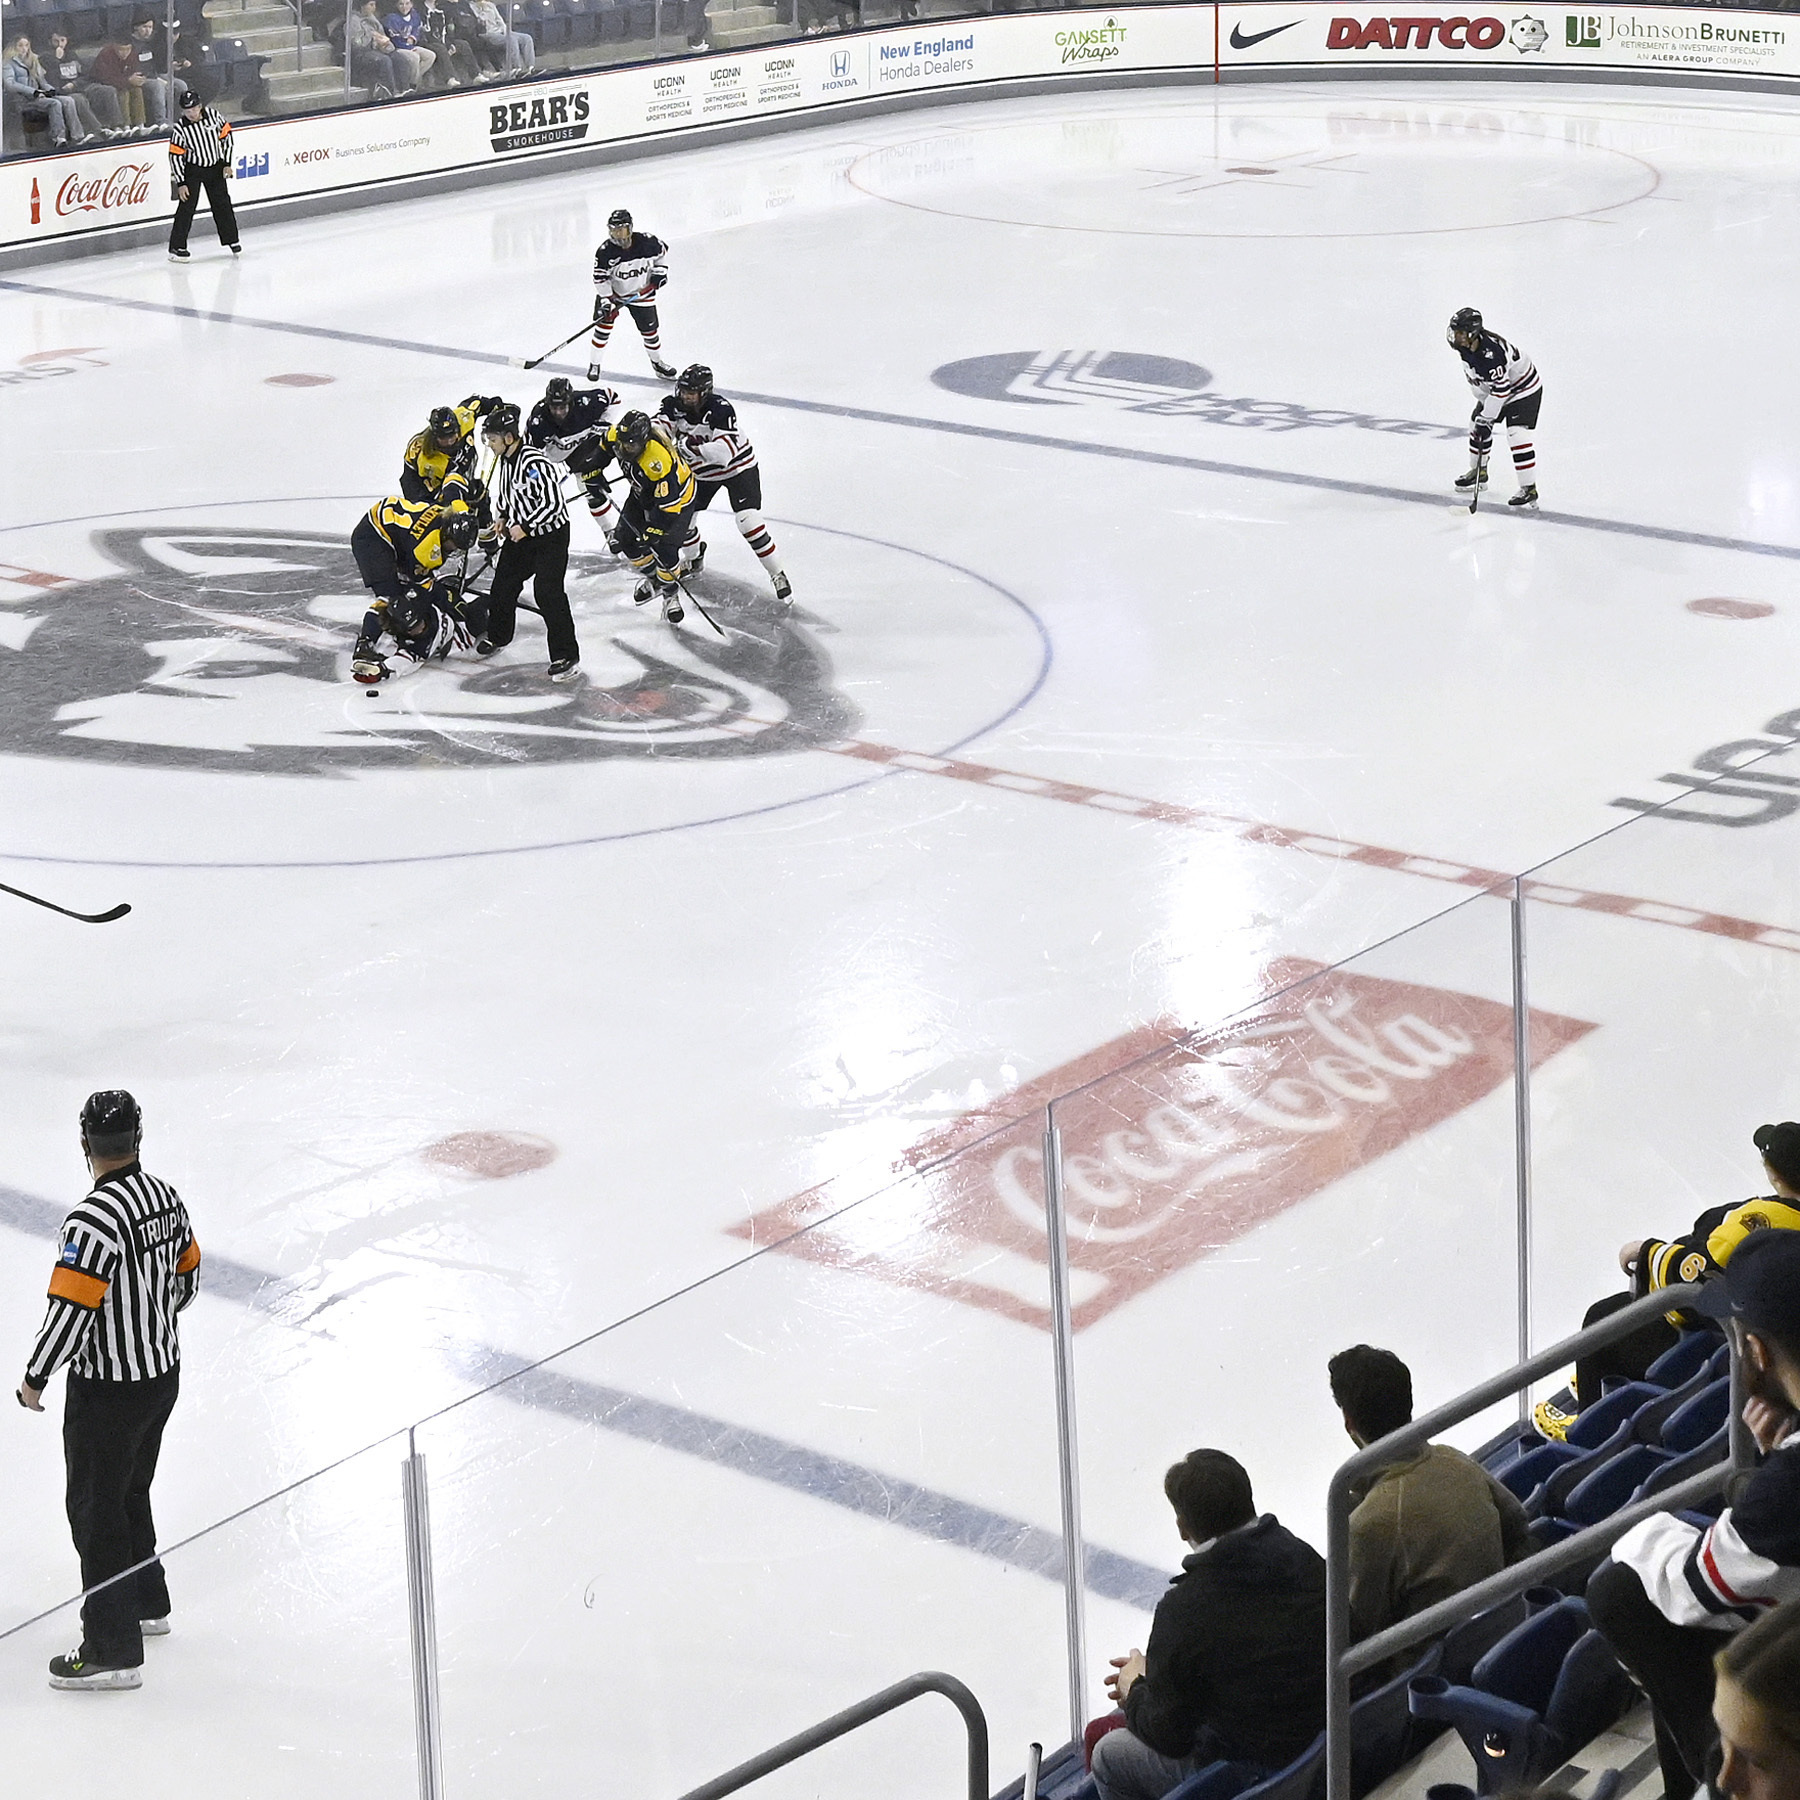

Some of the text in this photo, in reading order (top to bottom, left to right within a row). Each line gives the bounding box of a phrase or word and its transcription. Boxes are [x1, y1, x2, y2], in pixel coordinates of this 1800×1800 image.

[1054, 27, 1127, 46] GANSETT
[1325, 17, 1505, 50] DATTCO
[880, 34, 974, 61] New England
[1061, 37, 1120, 64] Wraps
[1620, 41, 1776, 57] RETIREMENT INVESTMENT SPECIALISTS
[764, 59, 795, 73] UCONN
[1651, 54, 1761, 67] ALERA GROUP COMPANY
[710, 67, 741, 82] UCONN
[768, 71, 792, 80] HEALTH
[879, 56, 974, 82] Honda Dealers
[653, 75, 685, 90] UCONN
[713, 79, 738, 88] HEALTH
[822, 78, 858, 91] HONDA
[657, 87, 682, 97] HEALTH
[490, 91, 590, 135] BEAR'S
[507, 128, 574, 149] SMOKEHOUSE
[293, 146, 331, 166] xerox
[366, 142, 397, 154] Solutions
[398, 136, 431, 150] Company
